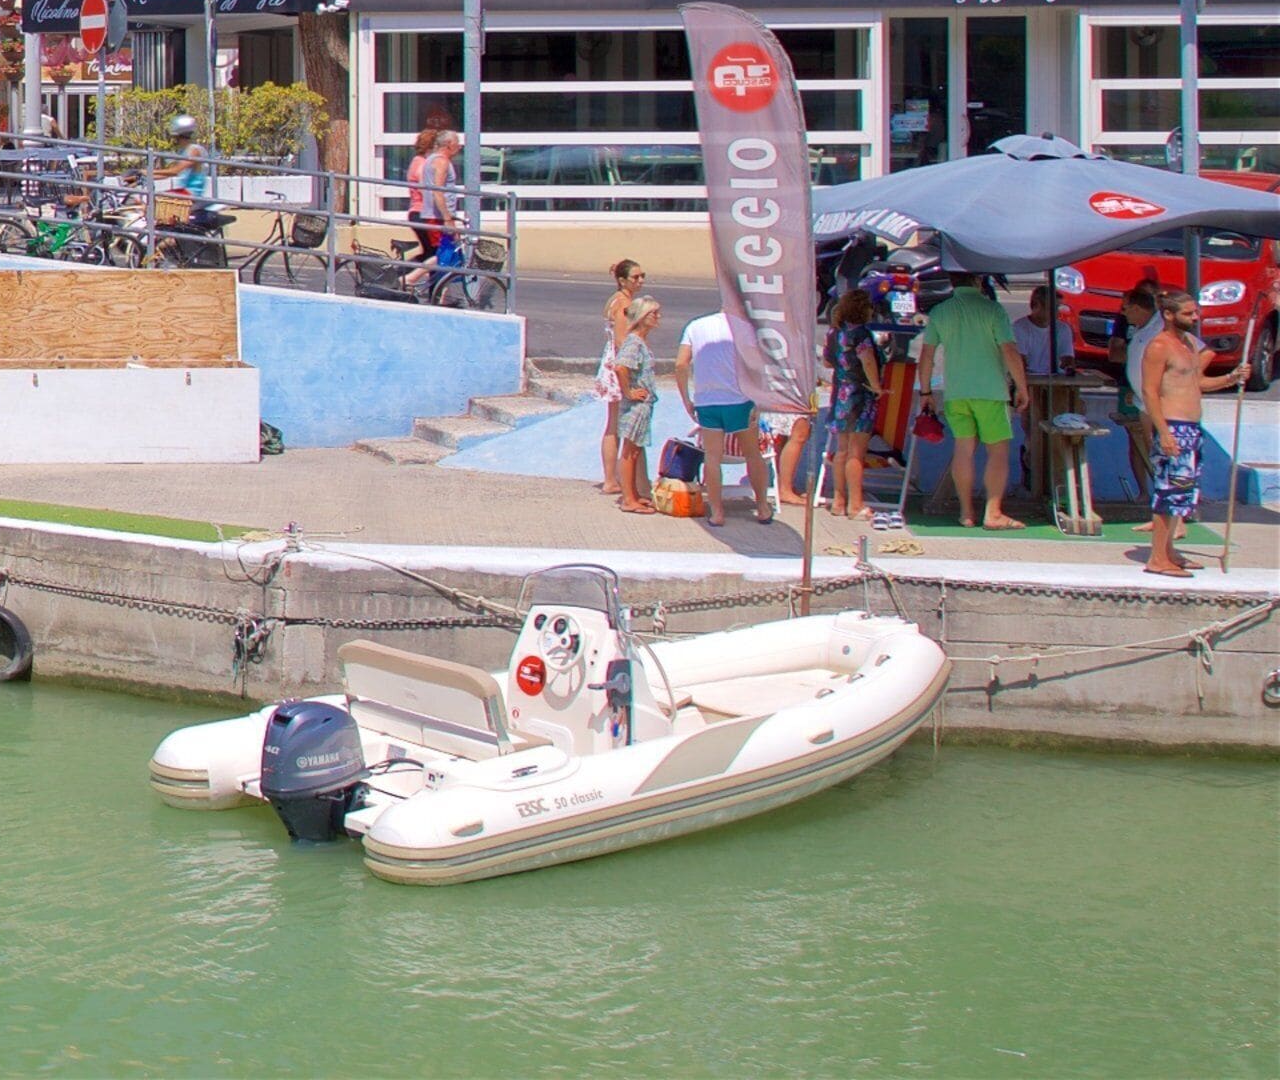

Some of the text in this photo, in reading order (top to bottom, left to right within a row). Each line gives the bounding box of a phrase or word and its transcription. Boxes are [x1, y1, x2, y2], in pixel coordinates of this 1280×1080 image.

[307, 752, 340, 766] YAMAHA
[554, 796, 568, 809] 50
[570, 789, 604, 806] classic
